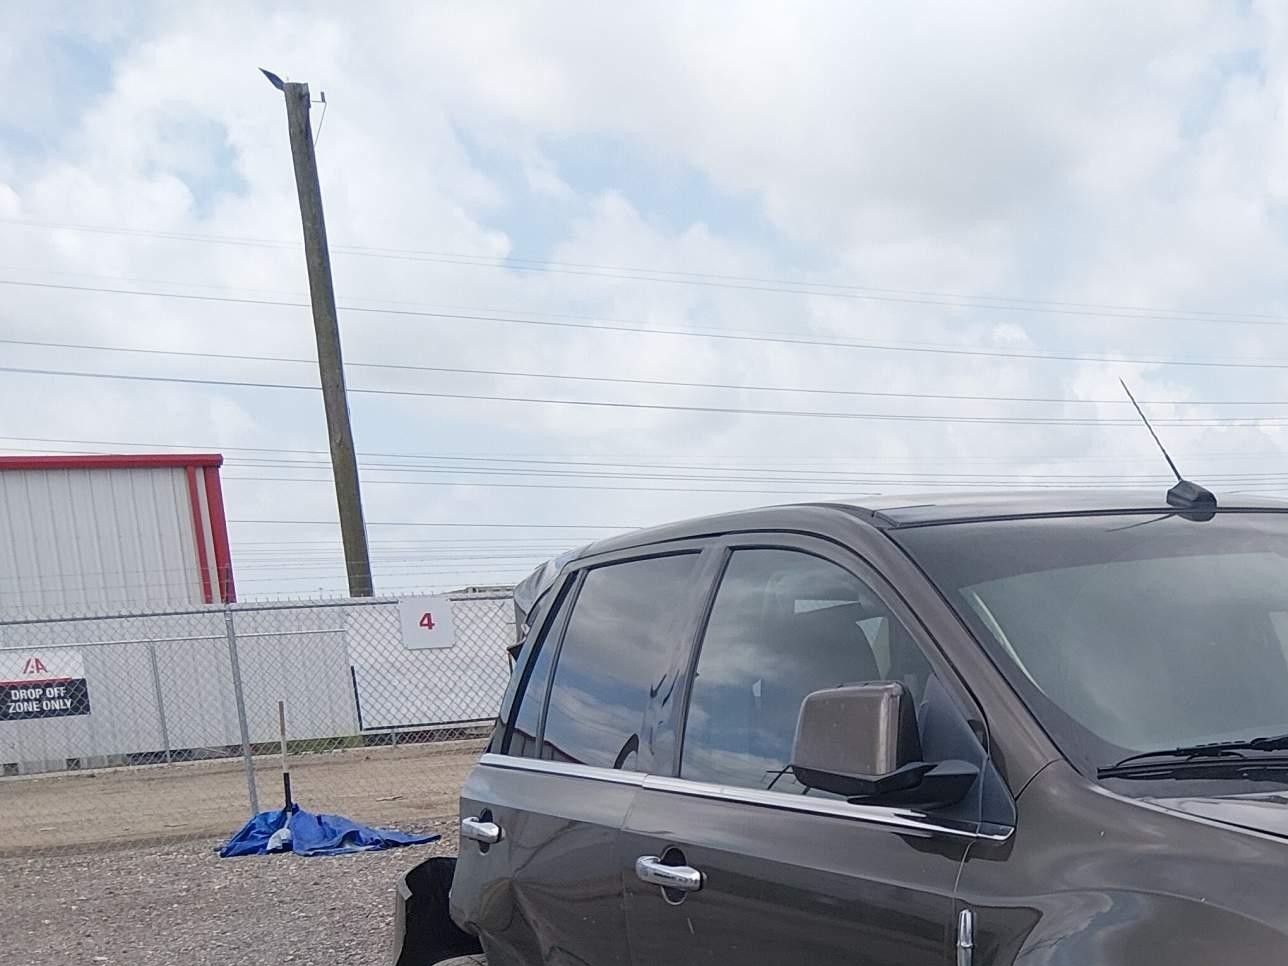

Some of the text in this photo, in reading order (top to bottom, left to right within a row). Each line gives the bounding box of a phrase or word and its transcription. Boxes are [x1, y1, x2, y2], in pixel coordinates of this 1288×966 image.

[420, 613, 435, 630] 4
[11, 686, 67, 701] DROP OFF
[8, 698, 72, 713] ZONE ONLY
